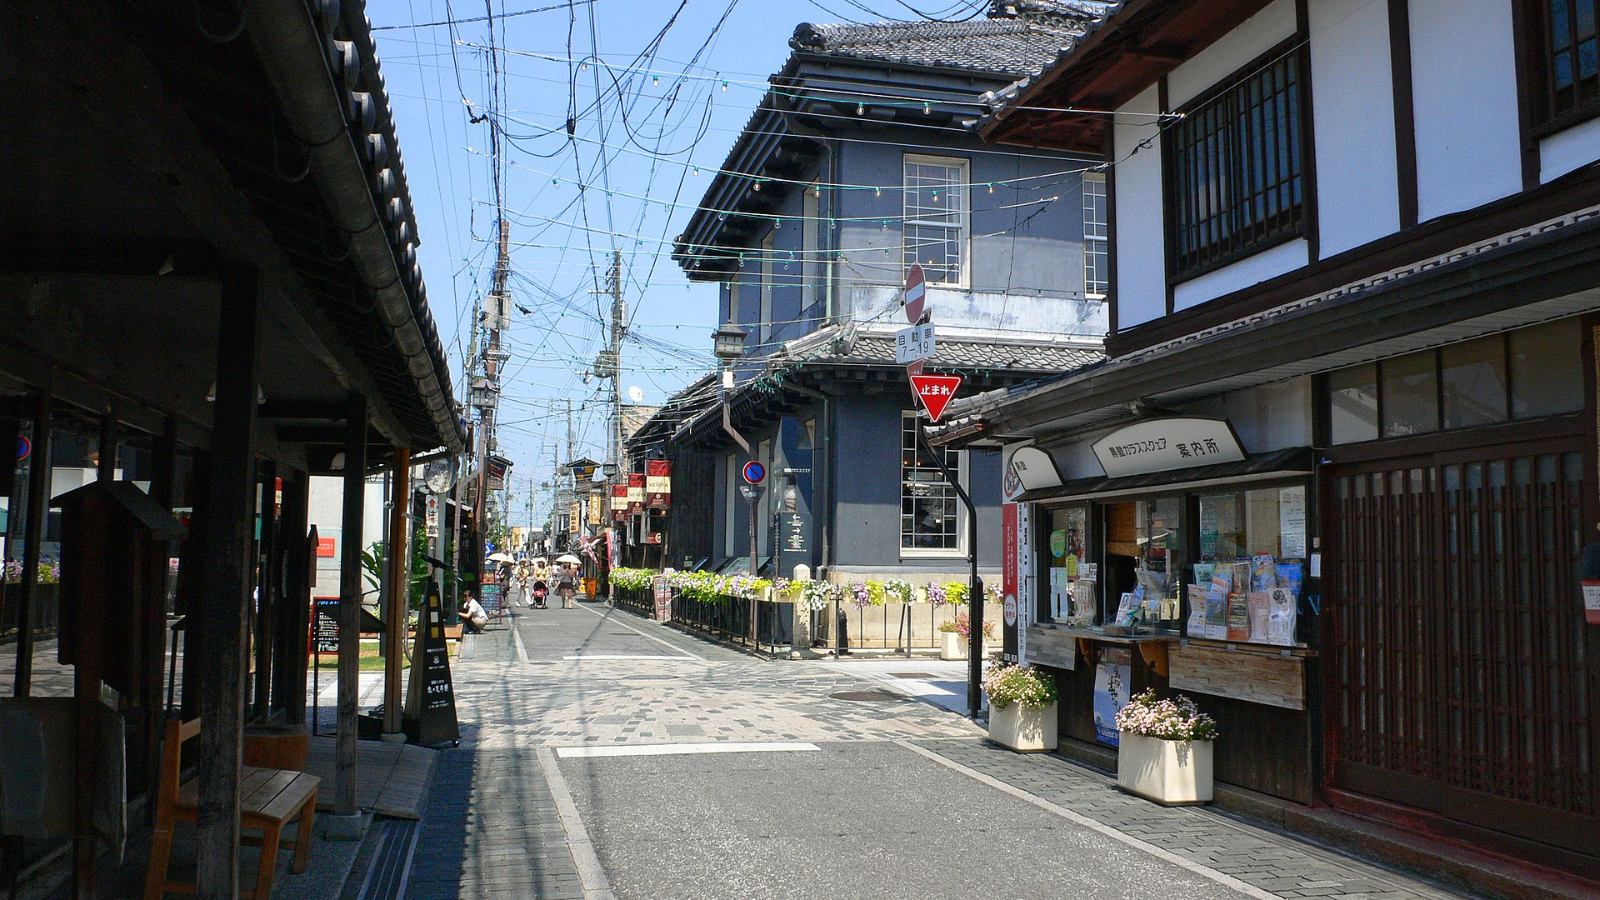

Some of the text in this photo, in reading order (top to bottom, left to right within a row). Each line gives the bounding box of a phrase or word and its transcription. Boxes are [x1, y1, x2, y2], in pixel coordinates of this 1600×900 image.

[899, 328, 931, 345] 自動車
[902, 341, 928, 358] 7-19
[921, 384, 950, 396] 止まれ
[1176, 438, 1220, 459] 案内所
